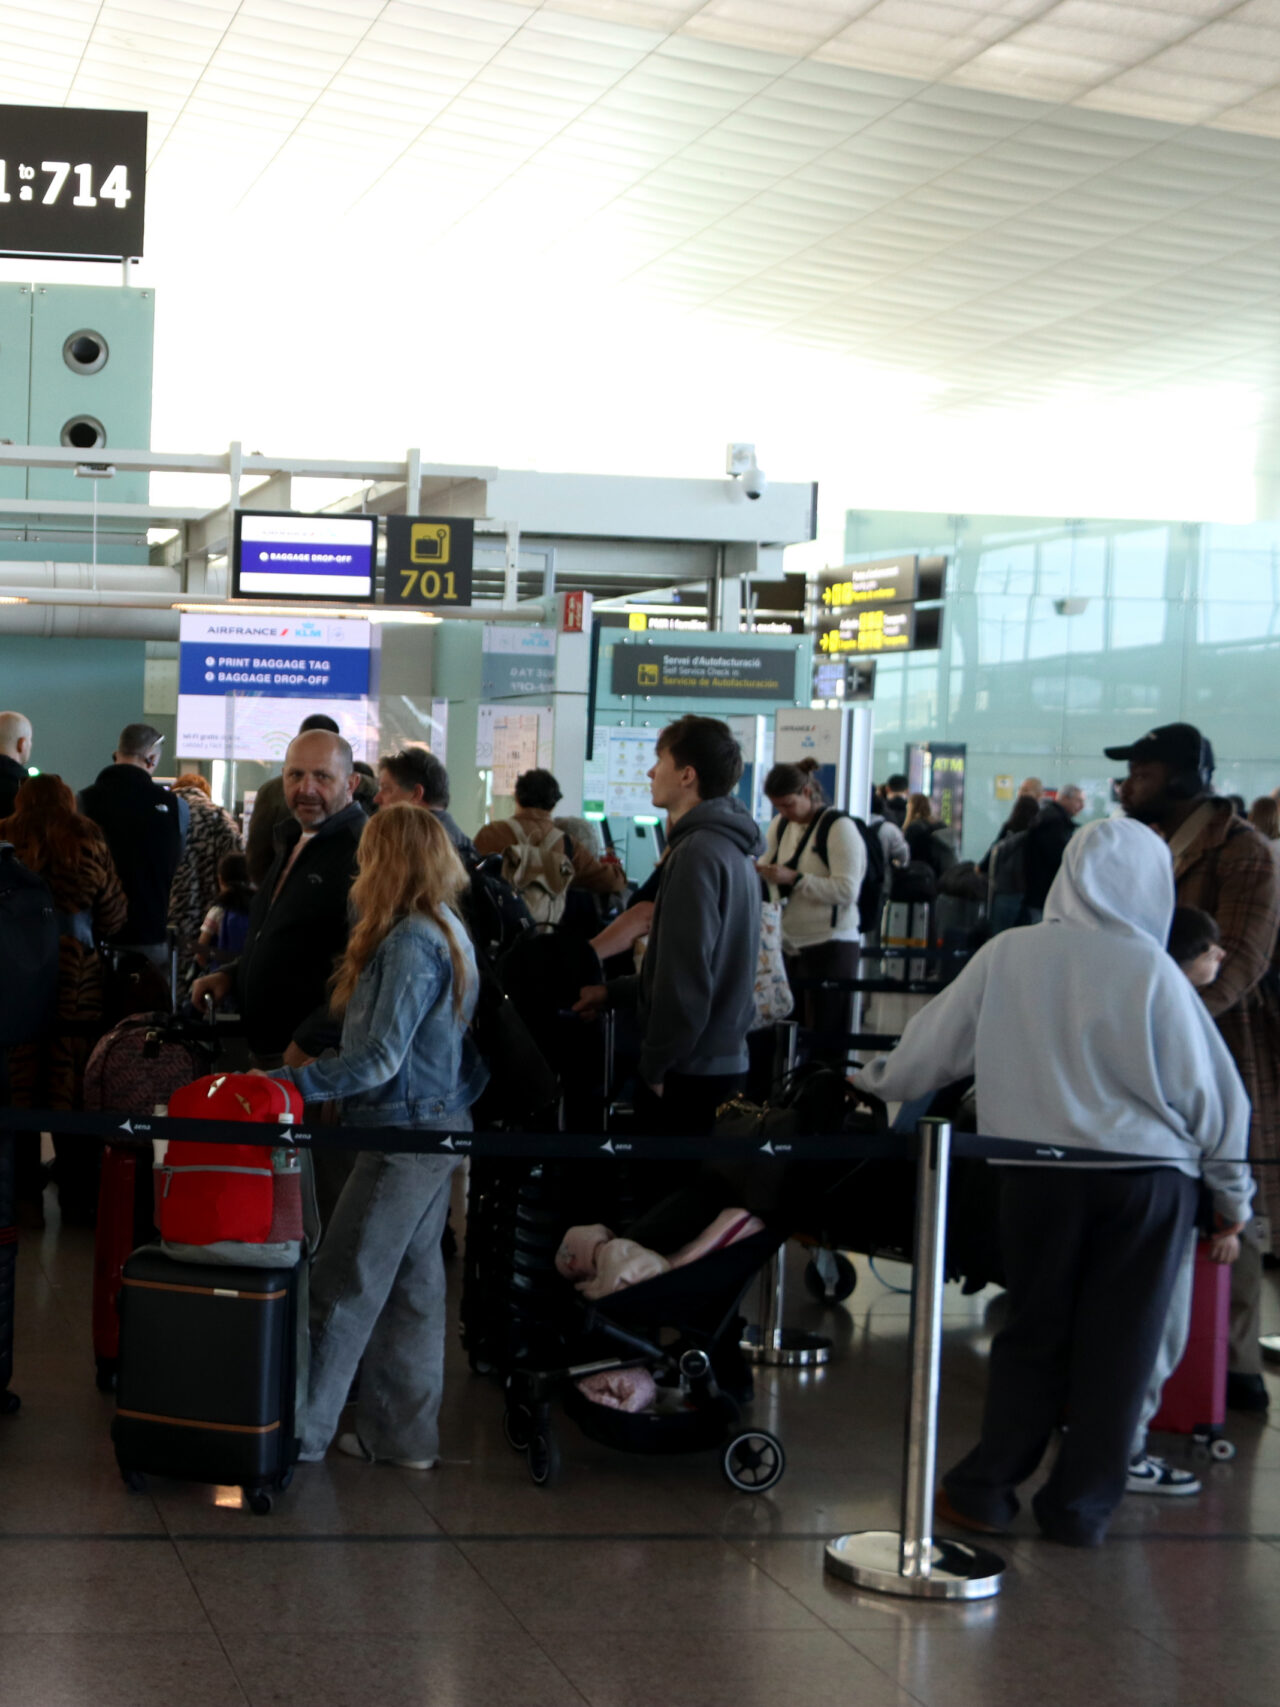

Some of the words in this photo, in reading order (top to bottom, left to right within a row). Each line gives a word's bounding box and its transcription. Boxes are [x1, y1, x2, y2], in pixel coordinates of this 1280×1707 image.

[18, 163, 35, 180] to
[41, 161, 132, 208] 714
[20, 185, 33, 201] a
[270, 552, 310, 562] BAGGAGE
[311, 554, 352, 563] DROP-OFF
[400, 570, 458, 599] 701
[207, 625, 277, 636] AIRFRANCE
[295, 629, 321, 638] KLM
[218, 657, 250, 667] PRINT
[253, 659, 305, 669] BAGGAGE
[308, 660, 330, 670] TAG
[663, 655, 690, 665] Servei
[218, 672, 270, 682] BAGGAGE
[274, 674, 328, 685] DROP-OFF
